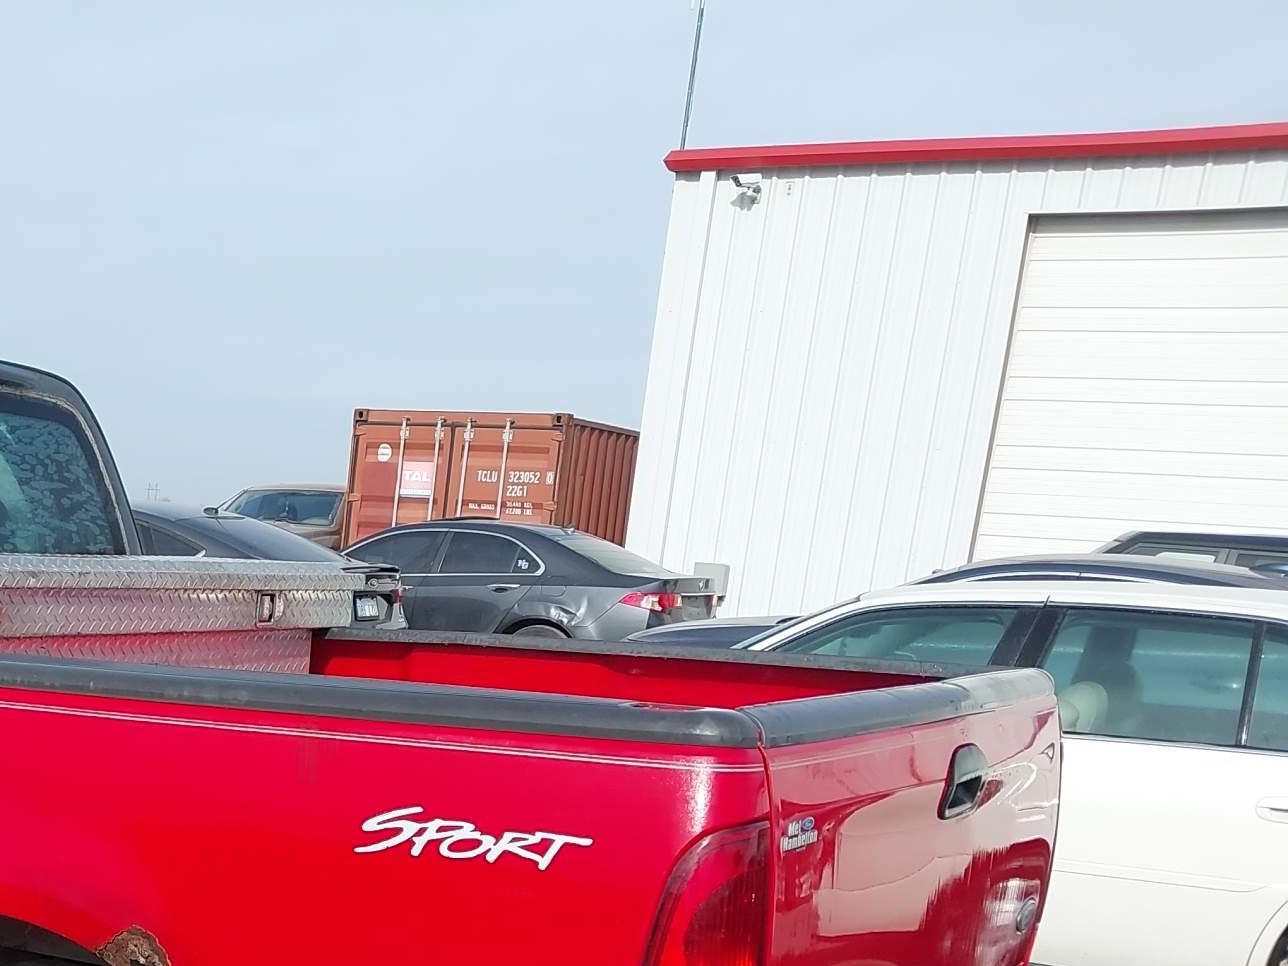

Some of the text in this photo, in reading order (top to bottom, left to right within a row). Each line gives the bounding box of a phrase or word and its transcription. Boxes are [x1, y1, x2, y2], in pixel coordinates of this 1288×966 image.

[405, 471, 432, 481] TAL
[477, 470, 498, 482] TCLU
[508, 471, 541, 483] 323052
[354, 806, 593, 870] SPORT
